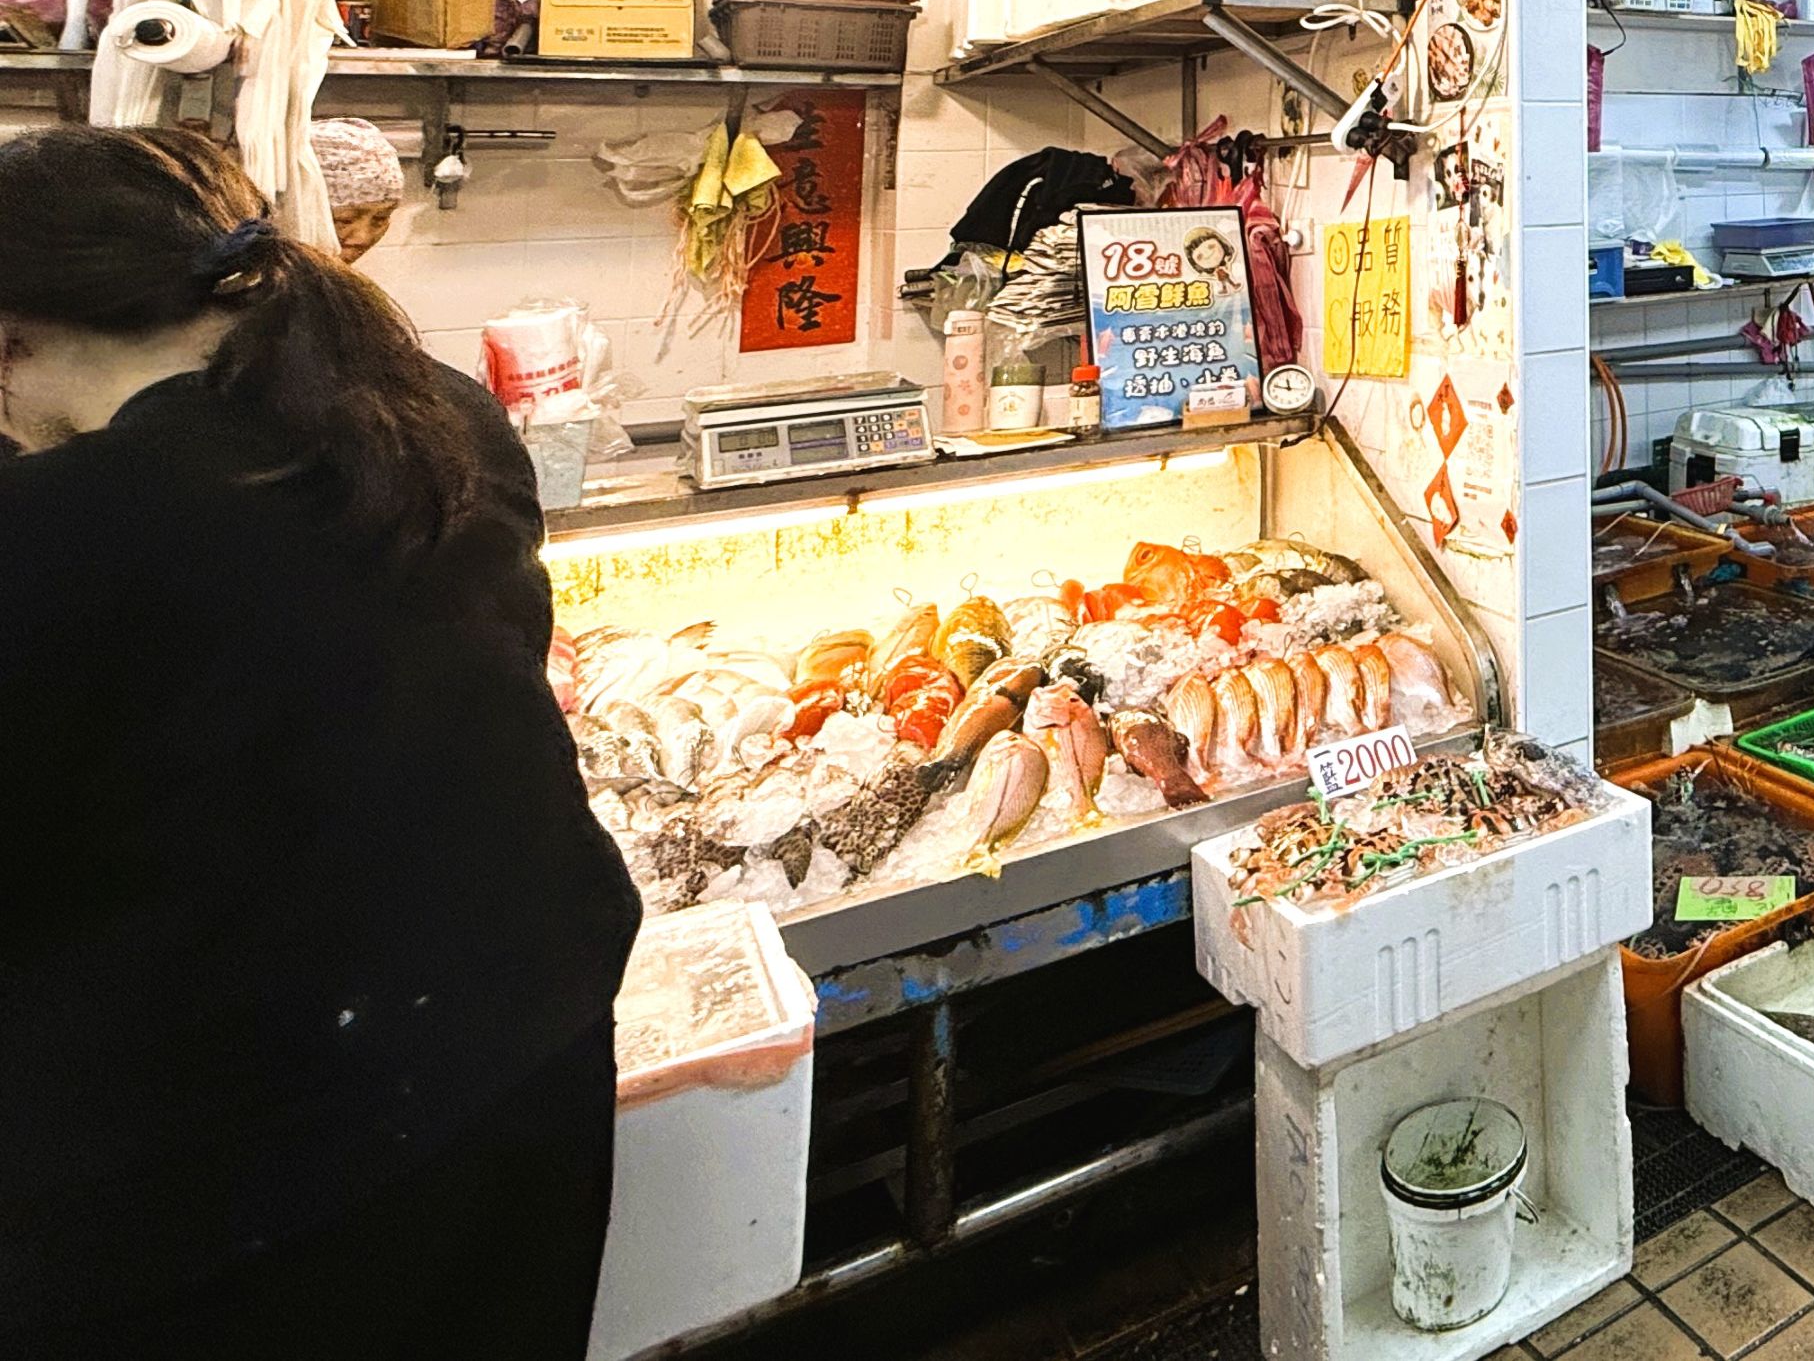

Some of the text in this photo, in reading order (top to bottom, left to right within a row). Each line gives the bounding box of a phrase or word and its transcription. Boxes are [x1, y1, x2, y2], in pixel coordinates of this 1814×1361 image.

[1102, 240, 1182, 280] 18號
[1354, 221, 1402, 273] 品質
[1106, 280, 1212, 312] 阿雪鮮魚
[1350, 289, 1402, 337] 服務
[1133, 341, 1228, 369] 野生海魚
[1337, 734, 1412, 786] 2000
